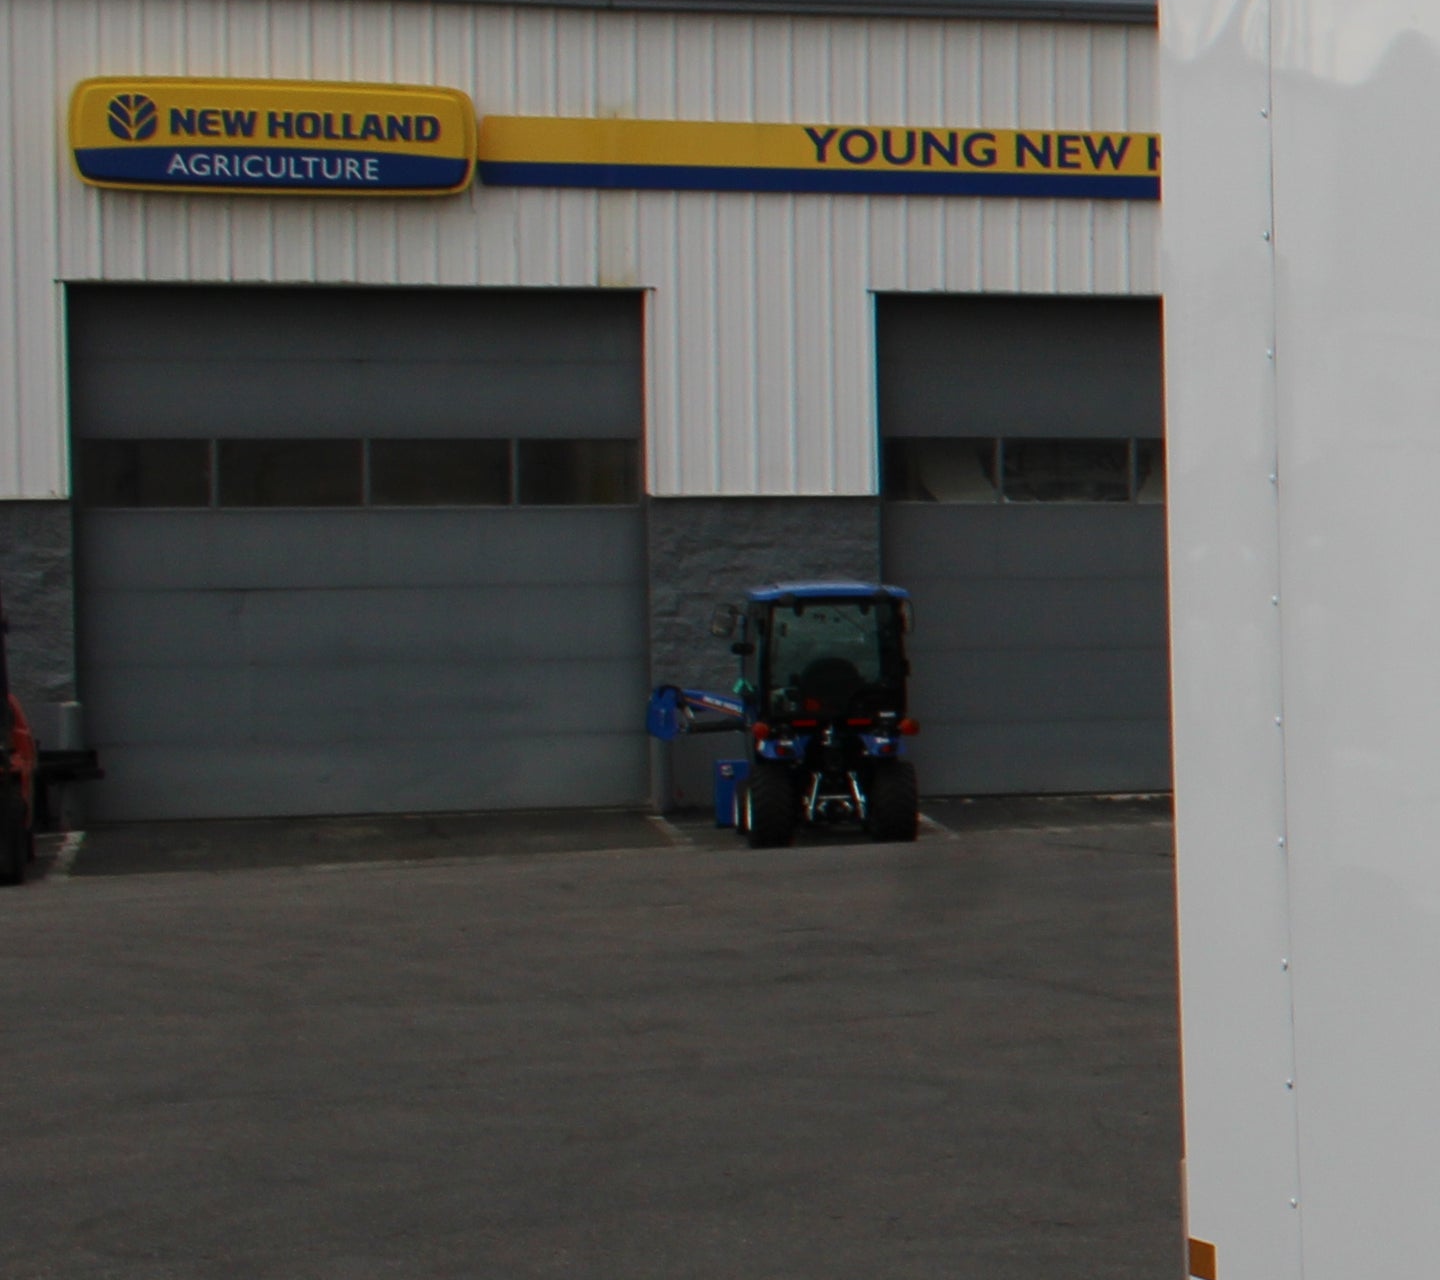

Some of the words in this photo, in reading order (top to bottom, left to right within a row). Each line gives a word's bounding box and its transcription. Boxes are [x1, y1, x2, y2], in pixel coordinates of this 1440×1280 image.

[169, 107, 257, 138] NEW
[268, 110, 442, 143] HOLLAND
[804, 127, 997, 168] YOUNG
[1015, 133, 1132, 170] NEW
[166, 153, 381, 181] AGRICULTURE
